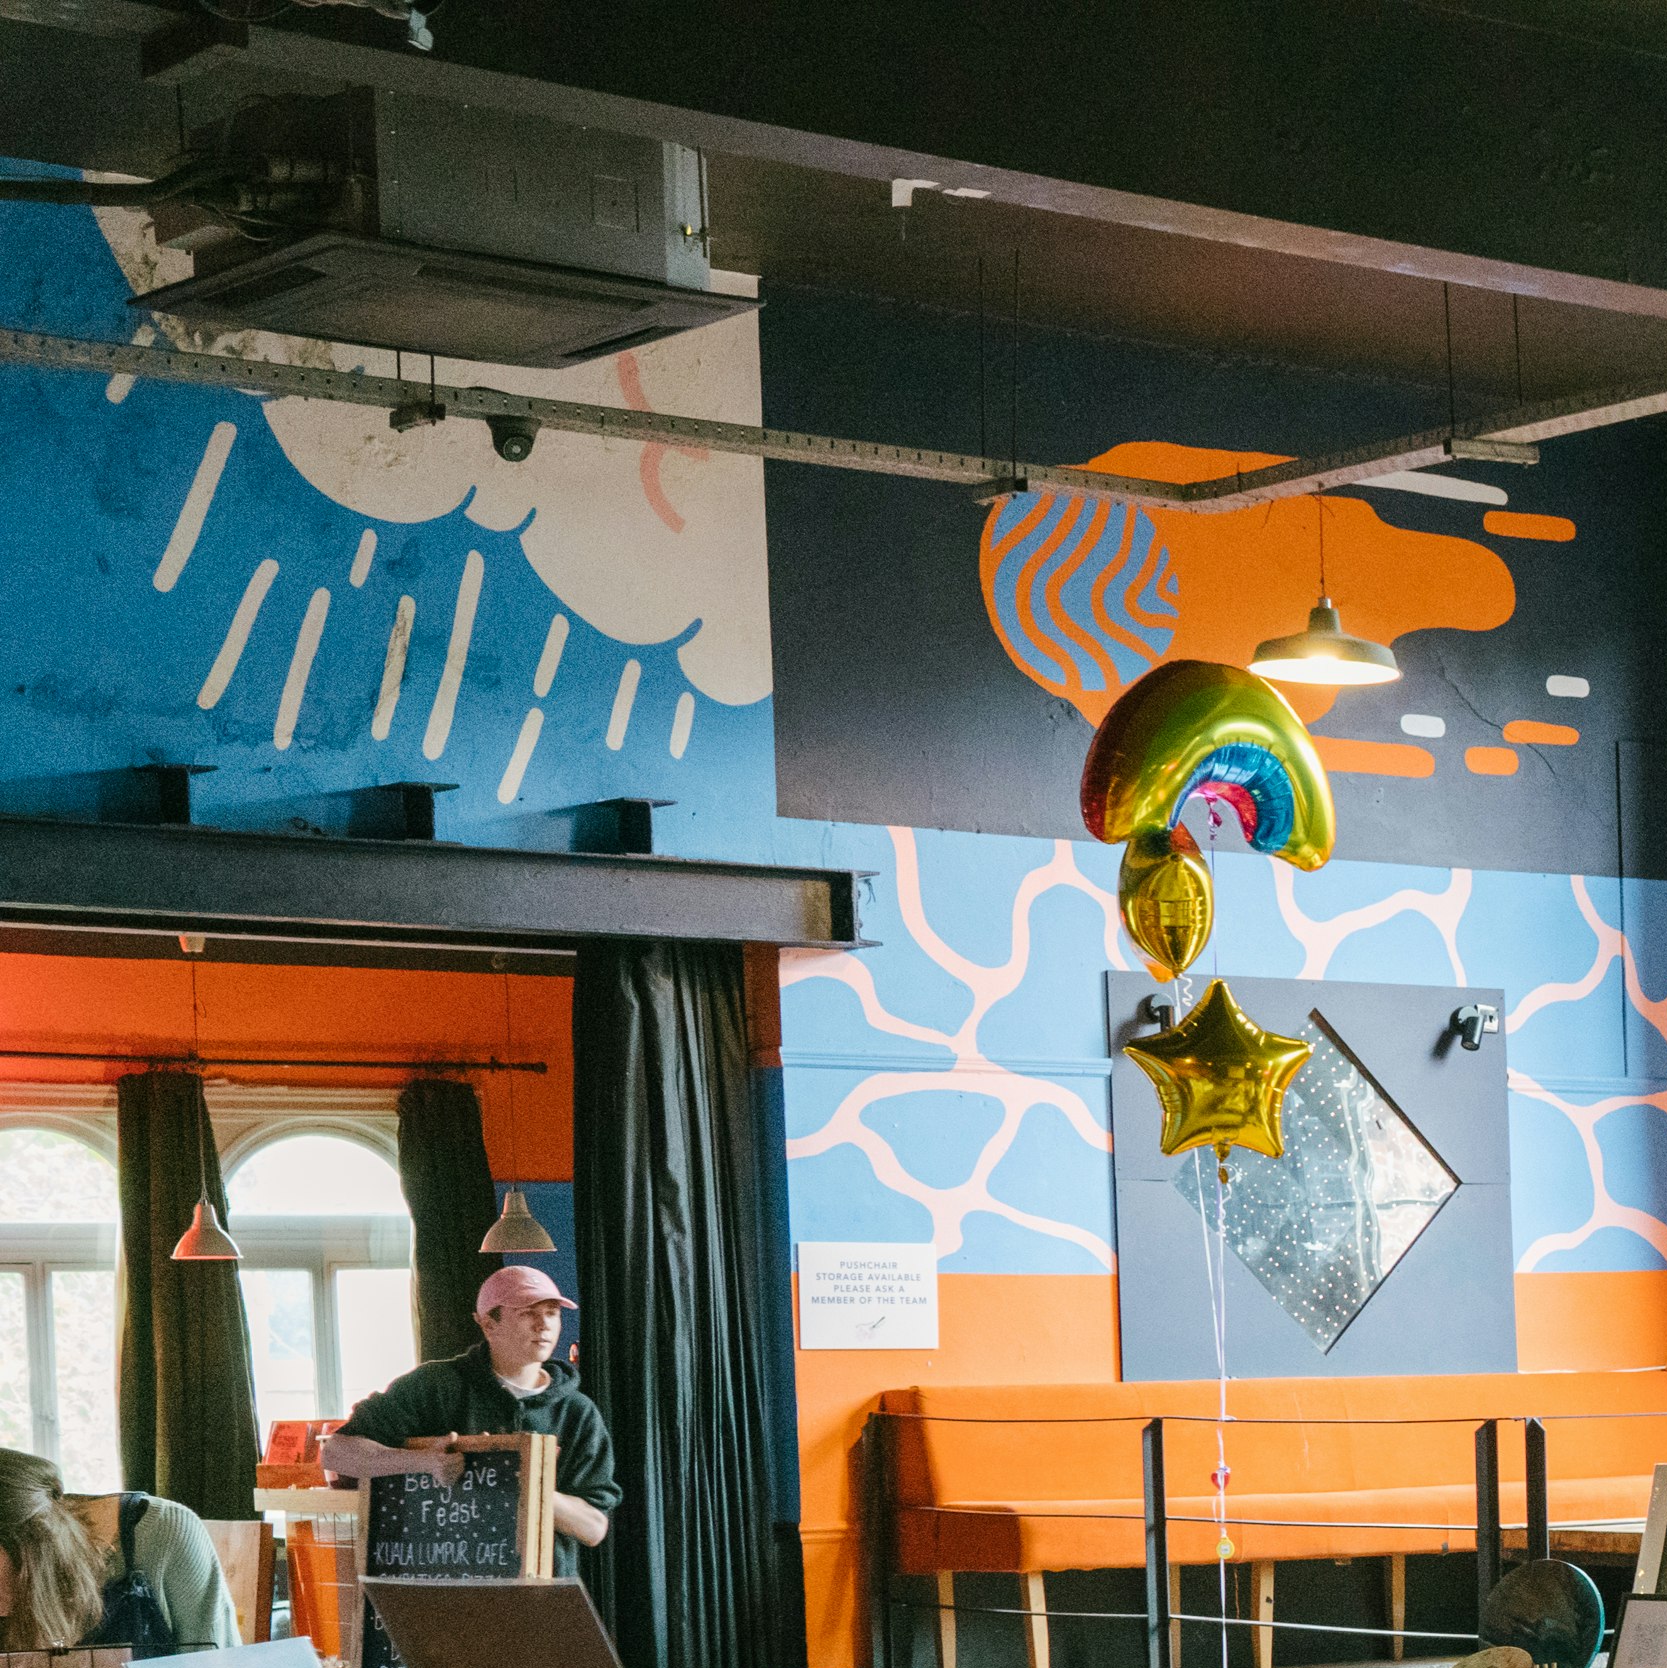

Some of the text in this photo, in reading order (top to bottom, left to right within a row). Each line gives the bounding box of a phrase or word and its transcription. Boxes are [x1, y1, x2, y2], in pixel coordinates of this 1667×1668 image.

[839, 1260, 898, 1270] PUSHCHAIR
[815, 1272, 921, 1282] STORAGE AVAILABLE
[833, 1284, 905, 1293] PLEASE ASK A
[811, 1296, 928, 1305] MEMBER OF THE TEAM
[421, 1500, 481, 1527] Feast
[375, 1538, 508, 1566] KUALA LUMPUR CAFÉ
